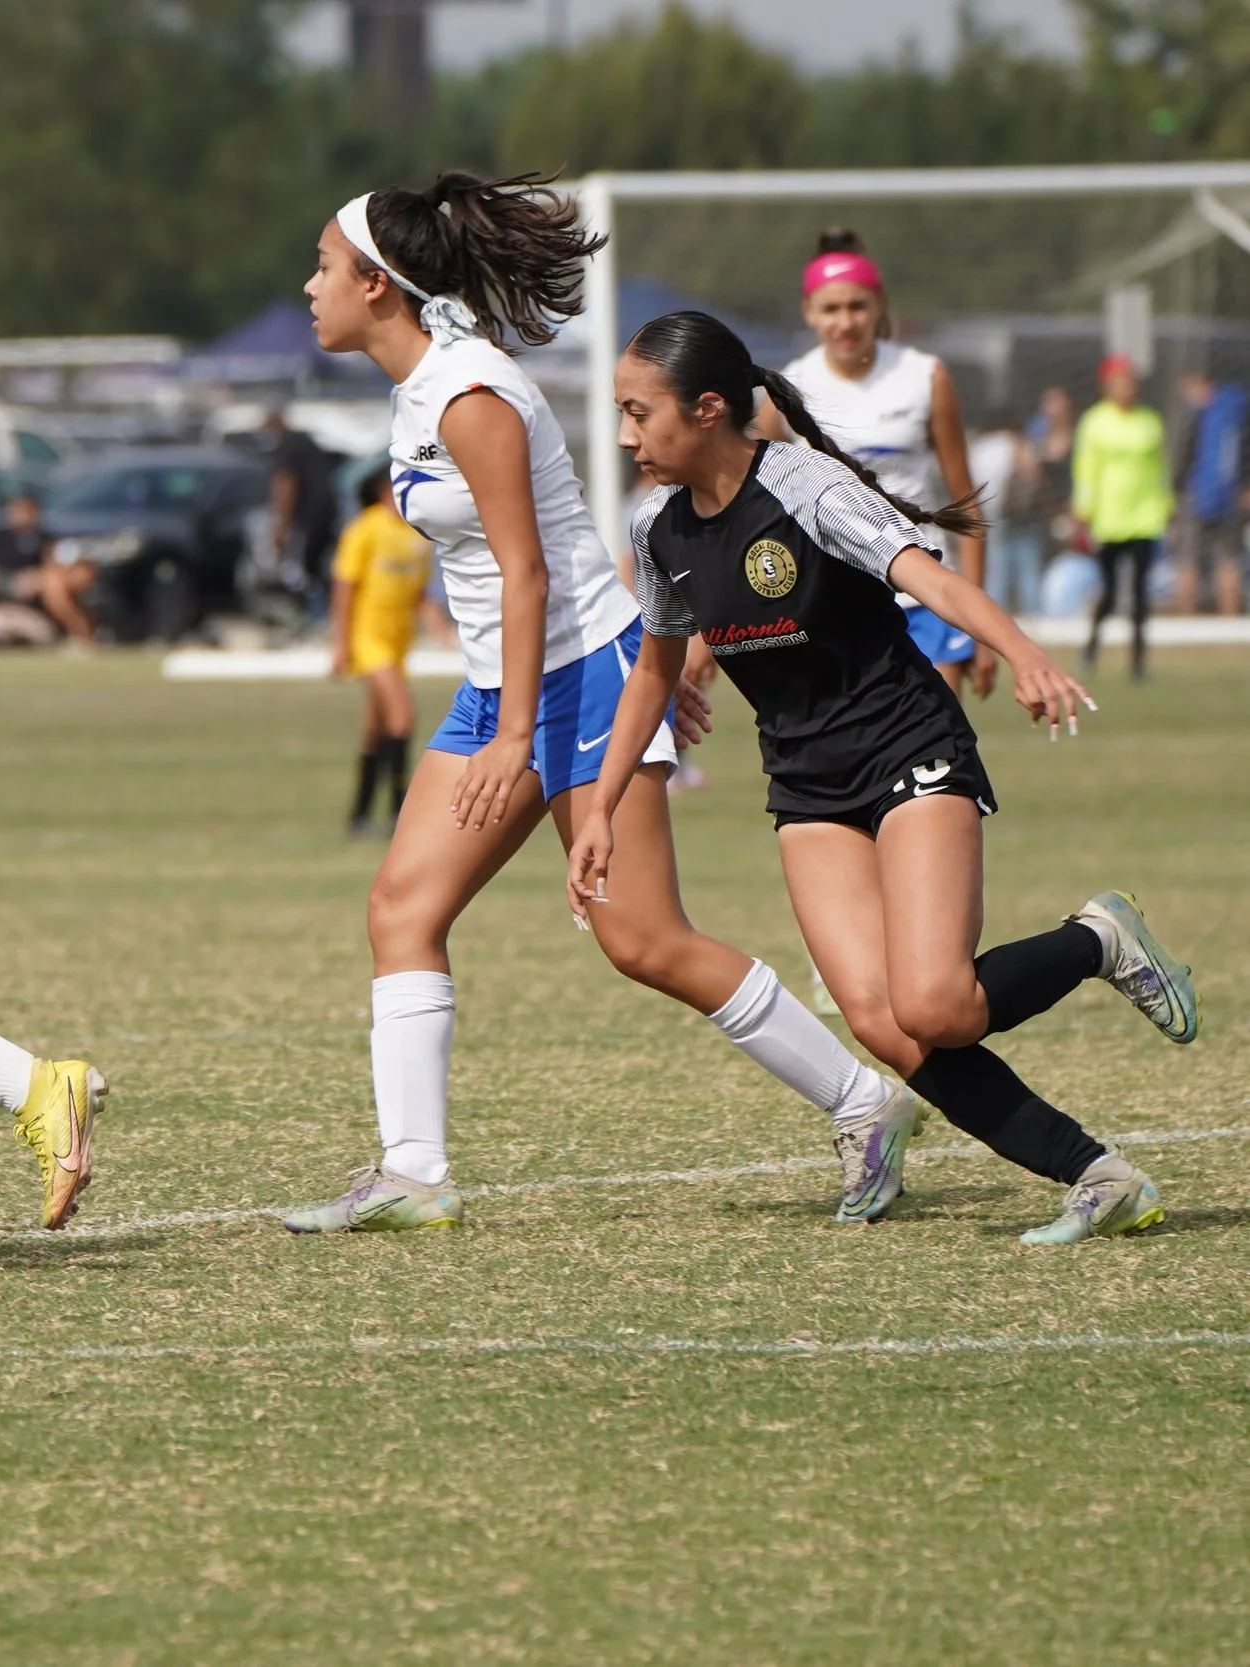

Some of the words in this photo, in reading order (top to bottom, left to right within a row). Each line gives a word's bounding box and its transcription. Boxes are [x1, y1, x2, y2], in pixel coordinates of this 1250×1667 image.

[409, 444, 437, 461] RF
[748, 543, 766, 562] SOCAL
[766, 541, 787, 557] ELITE
[750, 576, 786, 597] FOOTBALL
[782, 570, 796, 591] CLUB
[702, 617, 798, 645] alifornia
[707, 631, 808, 656] NSMISSION
